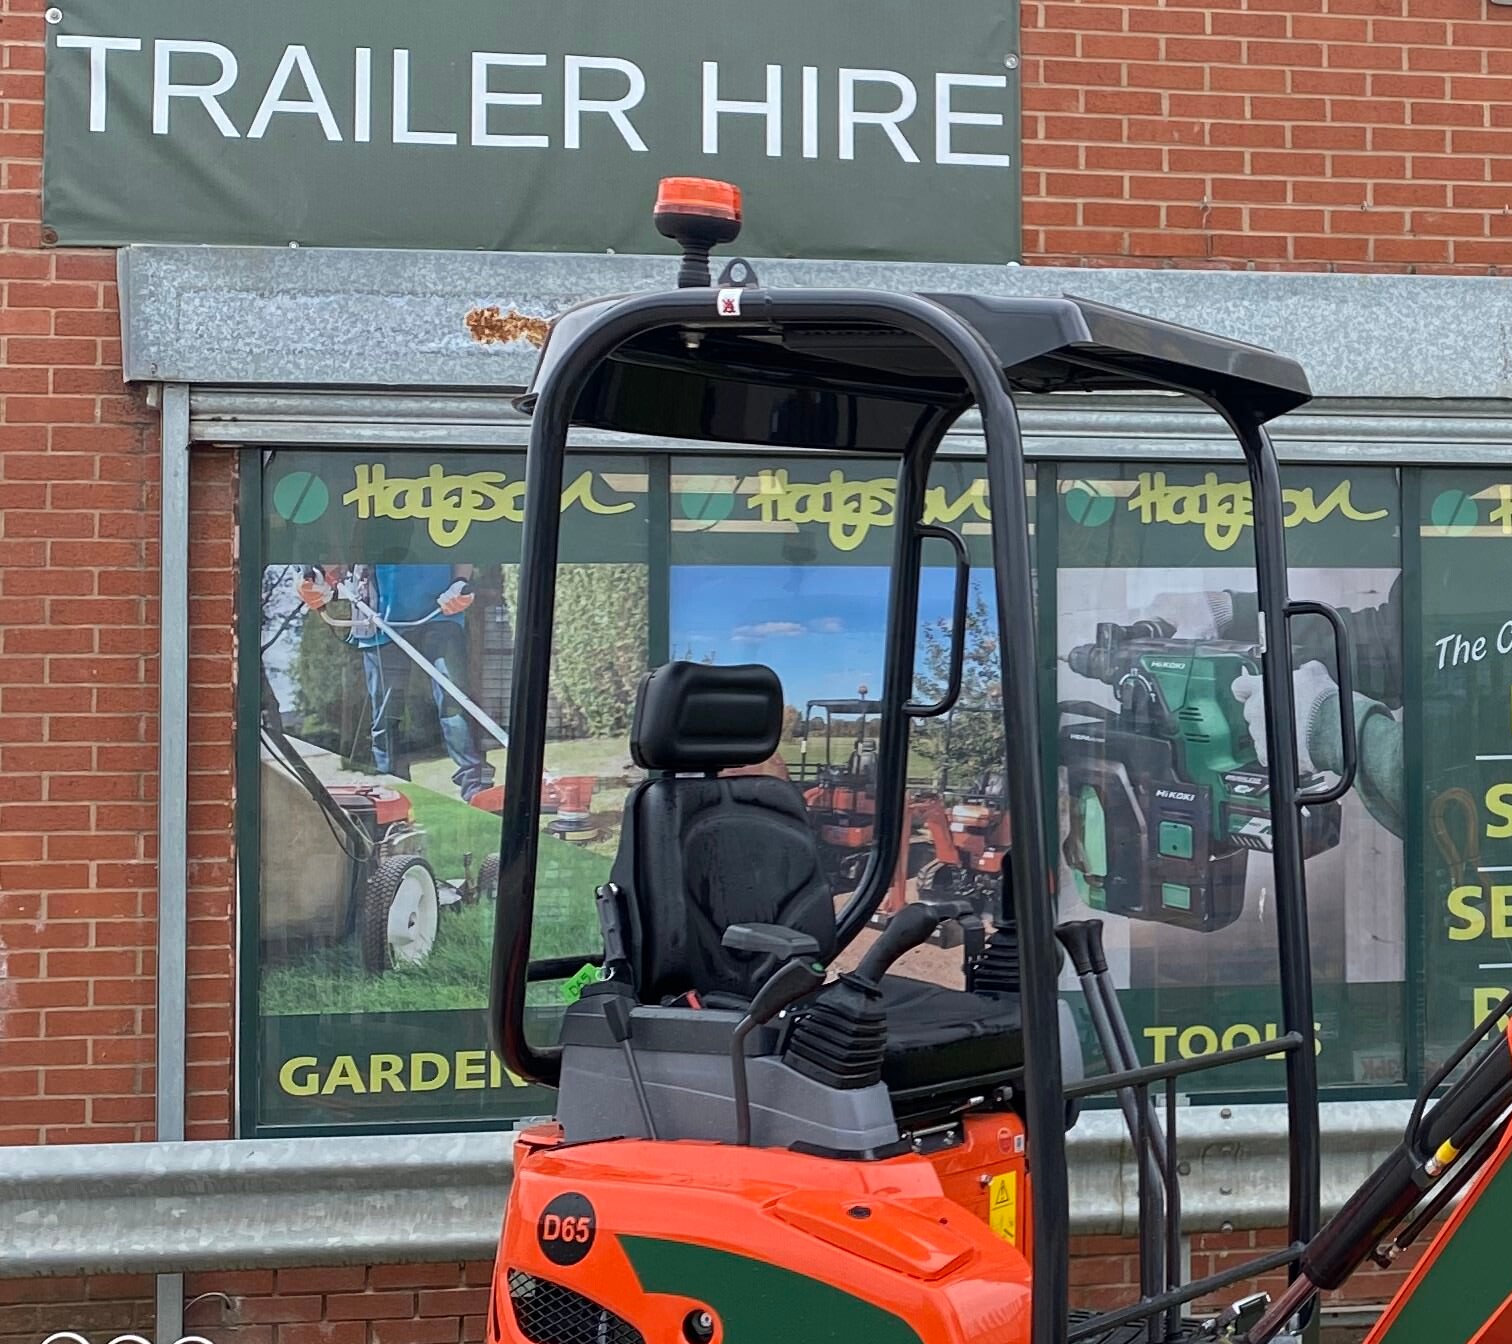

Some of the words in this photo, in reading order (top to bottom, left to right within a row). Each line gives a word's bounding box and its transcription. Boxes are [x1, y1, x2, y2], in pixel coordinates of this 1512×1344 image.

[56, 34, 649, 153] TRAILER
[702, 60, 1011, 167] HIRE
[1435, 633, 1486, 670] The
[543, 1214, 591, 1244] D65
